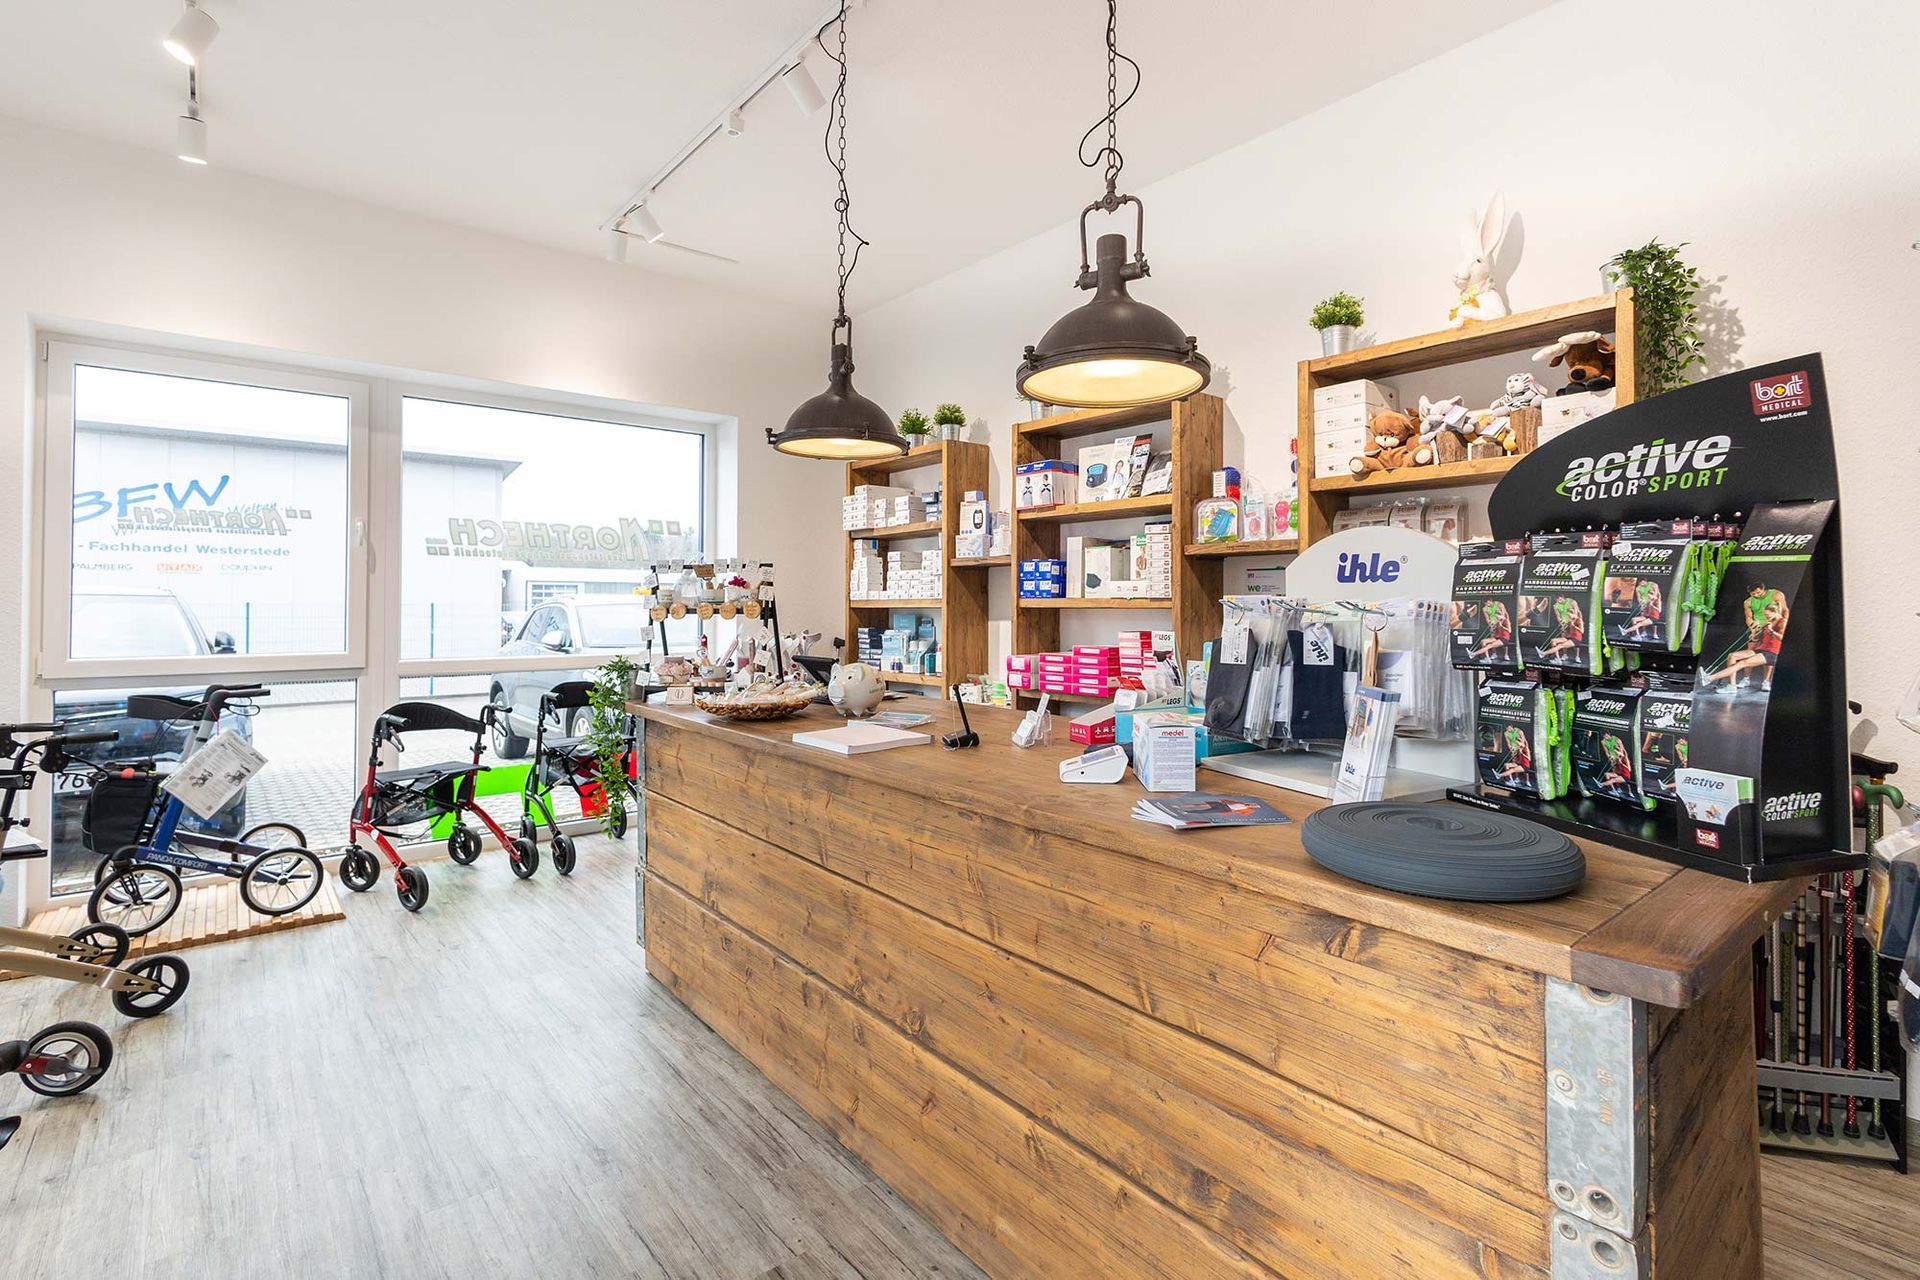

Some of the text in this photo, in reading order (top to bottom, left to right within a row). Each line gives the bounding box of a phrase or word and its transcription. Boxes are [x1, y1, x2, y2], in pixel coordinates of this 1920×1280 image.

[1754, 374, 1804, 401] bort
[1761, 399, 1803, 412] MEDICAL
[1759, 410, 1808, 423] www.bort.com
[1564, 434, 1732, 488] active
[1648, 467, 1729, 493] SPORT
[1746, 533, 1813, 545] active
[89, 541, 187, 553] Fachhandel
[196, 545, 290, 556] Westerstede
[1465, 569, 1507, 579] active
[1534, 562, 1582, 573] active
[1167, 697, 1182, 705] LEGS
[1489, 692, 1525, 704] active
[1588, 698, 1626, 711] active
[1650, 702, 1692, 715] activ
[1161, 729, 1185, 737] medel
[1684, 775, 1725, 790] active
[1764, 791, 1822, 813] active
[1793, 807, 1820, 819] SPORT
[146, 852, 208, 870] PANDA COMFORT
